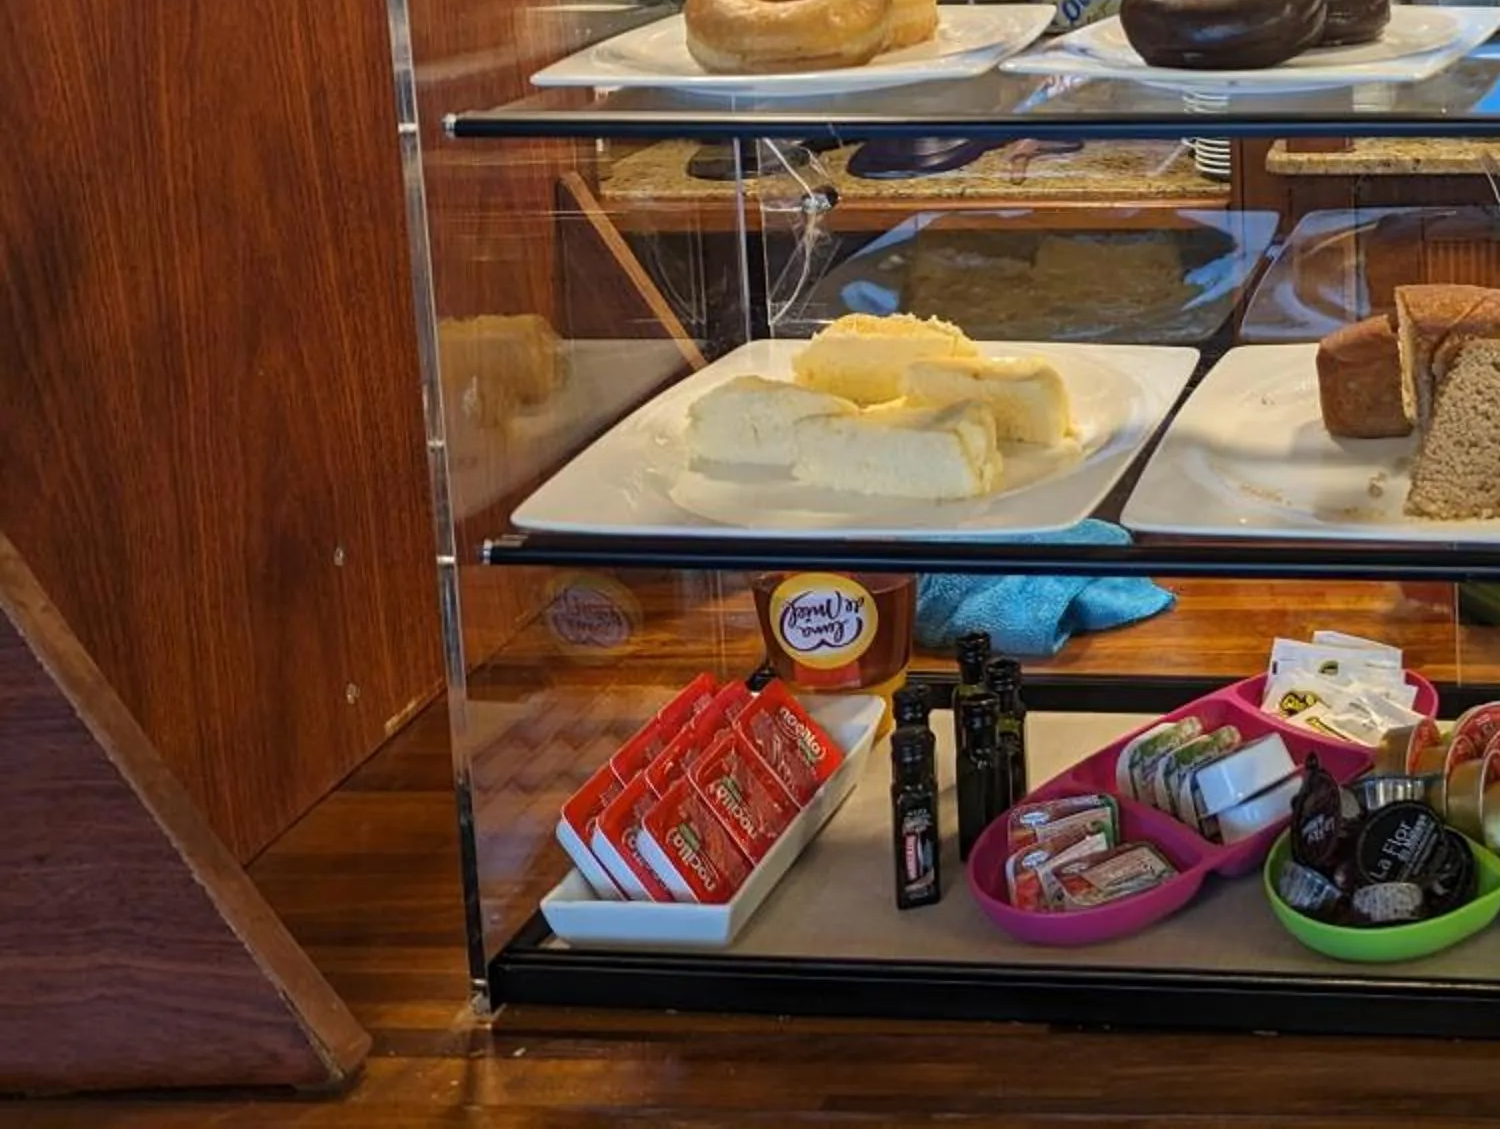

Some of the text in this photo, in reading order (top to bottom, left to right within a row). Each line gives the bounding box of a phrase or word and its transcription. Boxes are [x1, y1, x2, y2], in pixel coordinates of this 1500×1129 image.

[779, 707, 822, 756] nocilla
[715, 785, 759, 840] nocilla
[672, 833, 718, 892] nocilla
[1369, 858, 1393, 880] La
[1381, 820, 1412, 857] Flor
